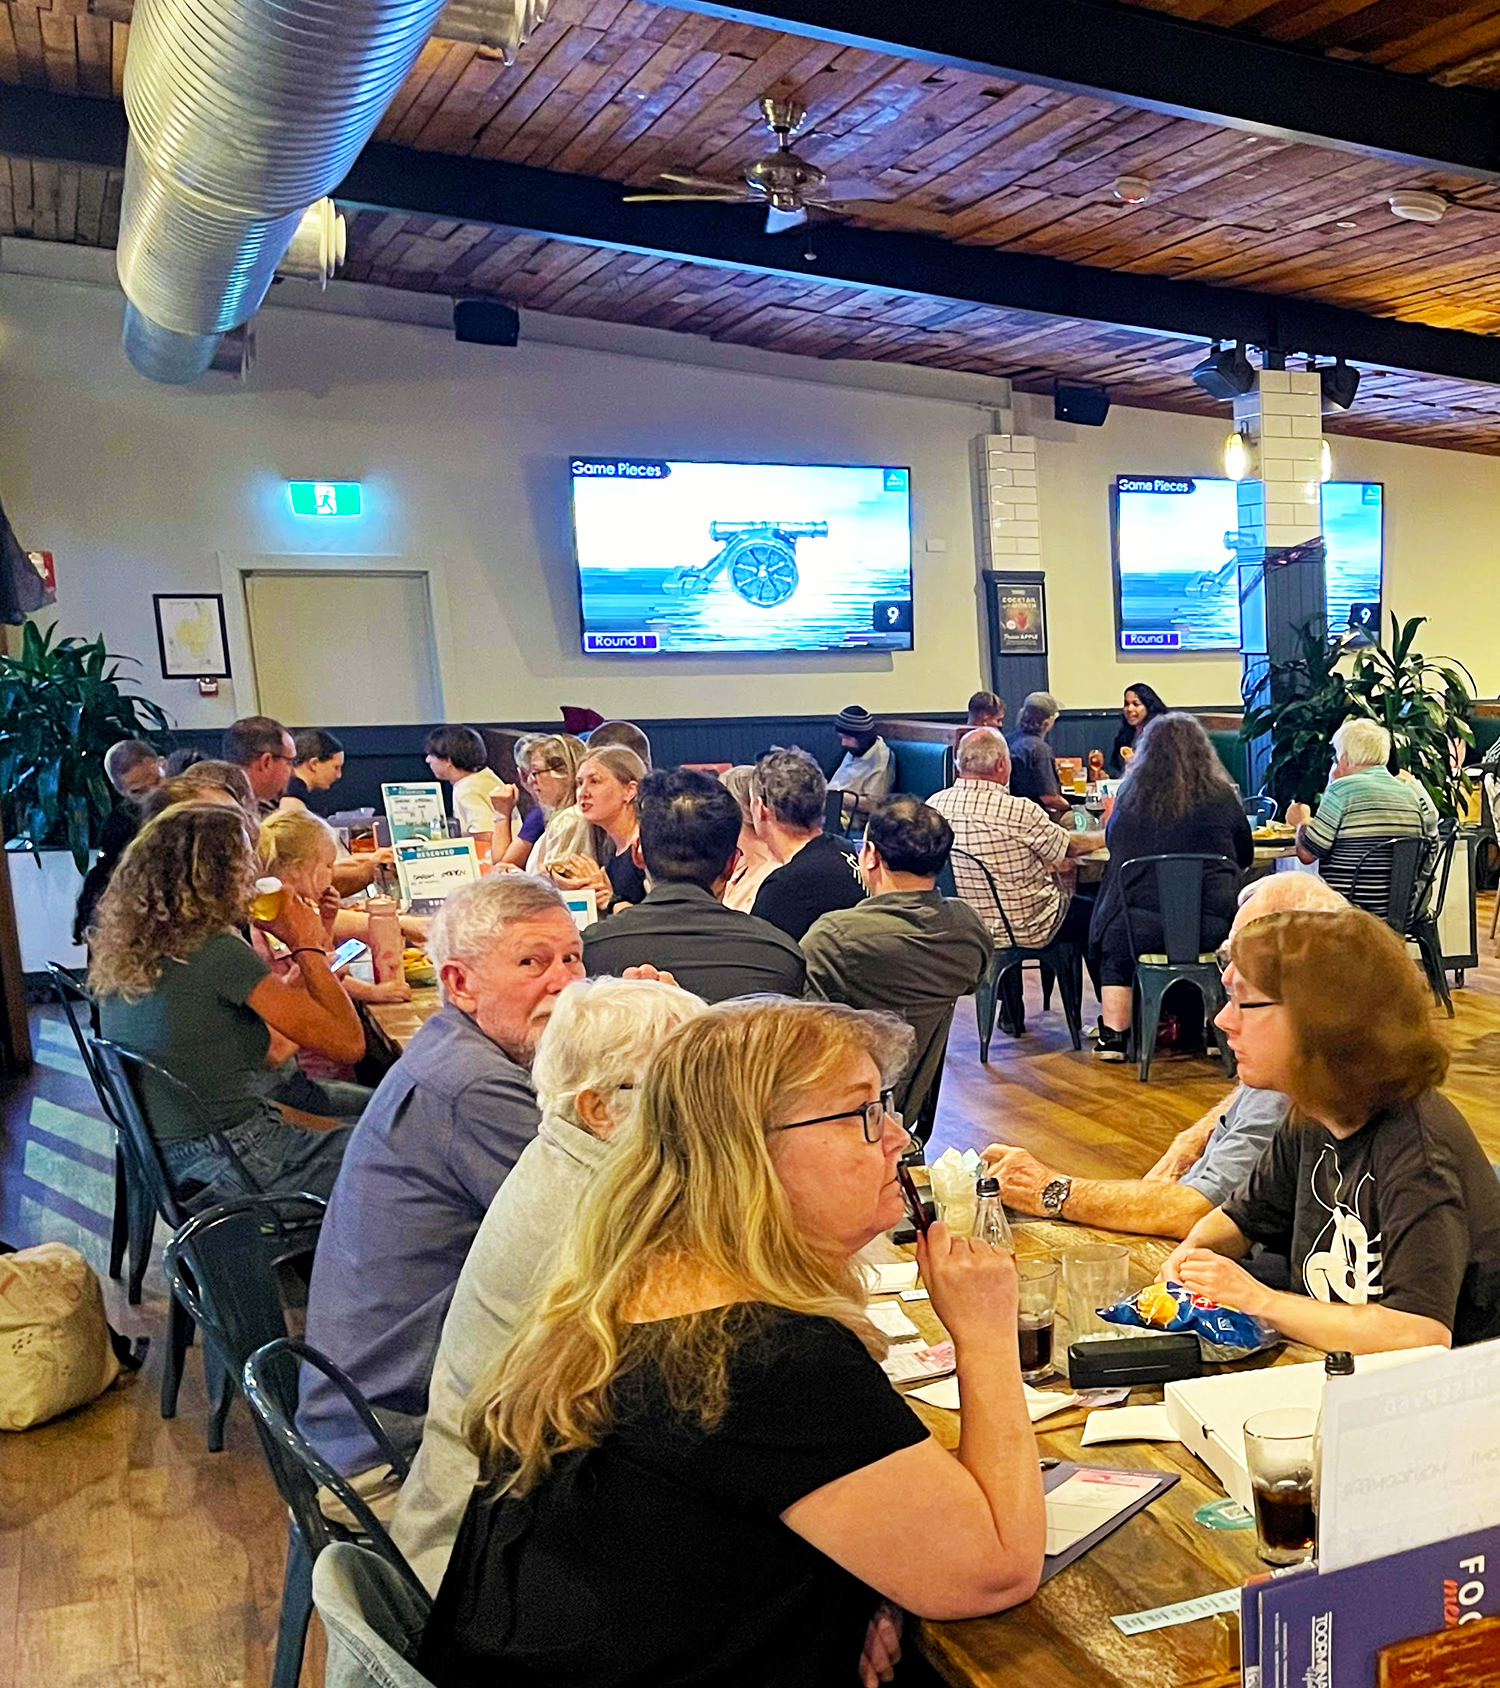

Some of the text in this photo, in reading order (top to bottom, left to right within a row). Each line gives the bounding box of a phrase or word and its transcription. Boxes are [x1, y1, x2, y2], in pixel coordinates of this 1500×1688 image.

[572, 460, 662, 477] Game Pieces
[1118, 478, 1189, 492] Game Pieces
[887, 606, 899, 624] 9
[1361, 607, 1372, 624] 9
[595, 635, 637, 647] Round
[1130, 634, 1163, 644] Round
